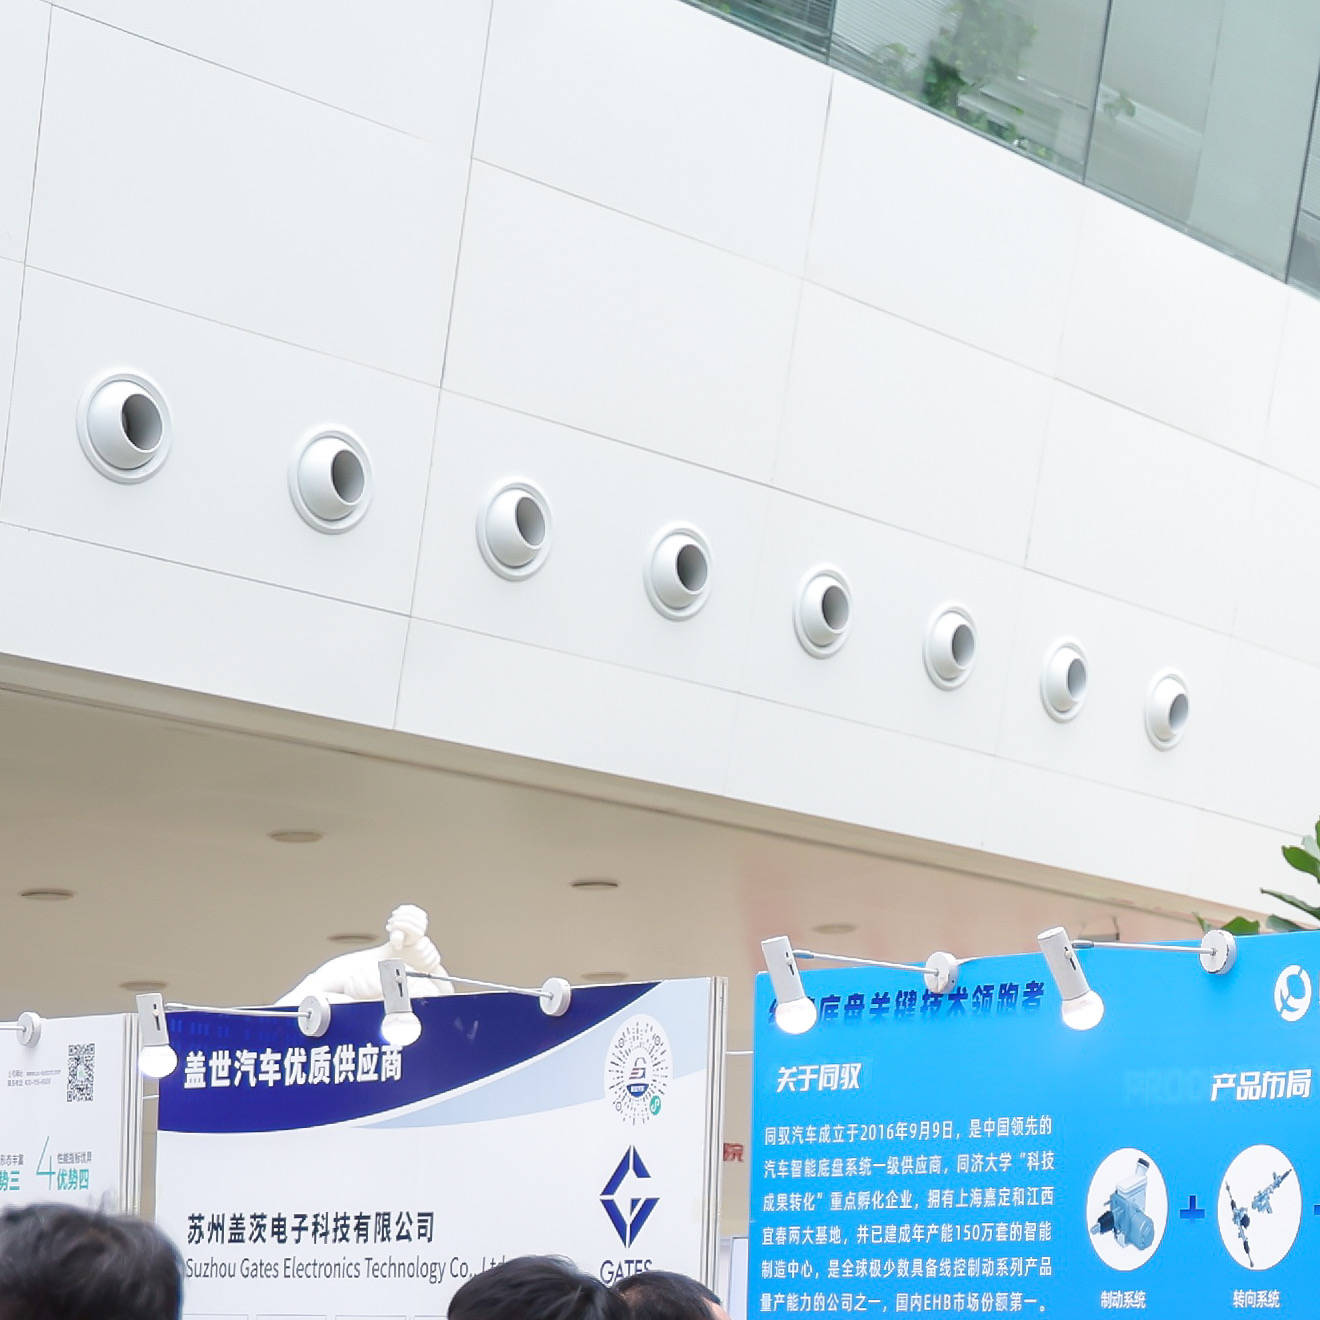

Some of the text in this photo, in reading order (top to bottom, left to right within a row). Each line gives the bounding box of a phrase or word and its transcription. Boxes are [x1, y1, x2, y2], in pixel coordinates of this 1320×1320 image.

[769, 980, 1045, 1024] 底盘关键技术领跑者
[183, 1043, 403, 1090] 盖世汽车优质供应商
[776, 1063, 863, 1093] 关于同驭
[1210, 1068, 1312, 1102] 产品布局
[764, 1114, 1053, 1146] 同驭汽车成立于2016年9月9日，是中国领先的
[57, 1168, 89, 1190] 优势四
[187, 1211, 435, 1246] 苏州盖茨电子科技有限公司
[185, 1256, 236, 1279] Suzhou
[240, 1257, 279, 1279] Gates
[283, 1256, 360, 1280] Electronics
[365, 1256, 446, 1284] Technology
[1100, 1289, 1147, 1310] 制动系统
[1233, 1288, 1280, 1309] 转向系统
